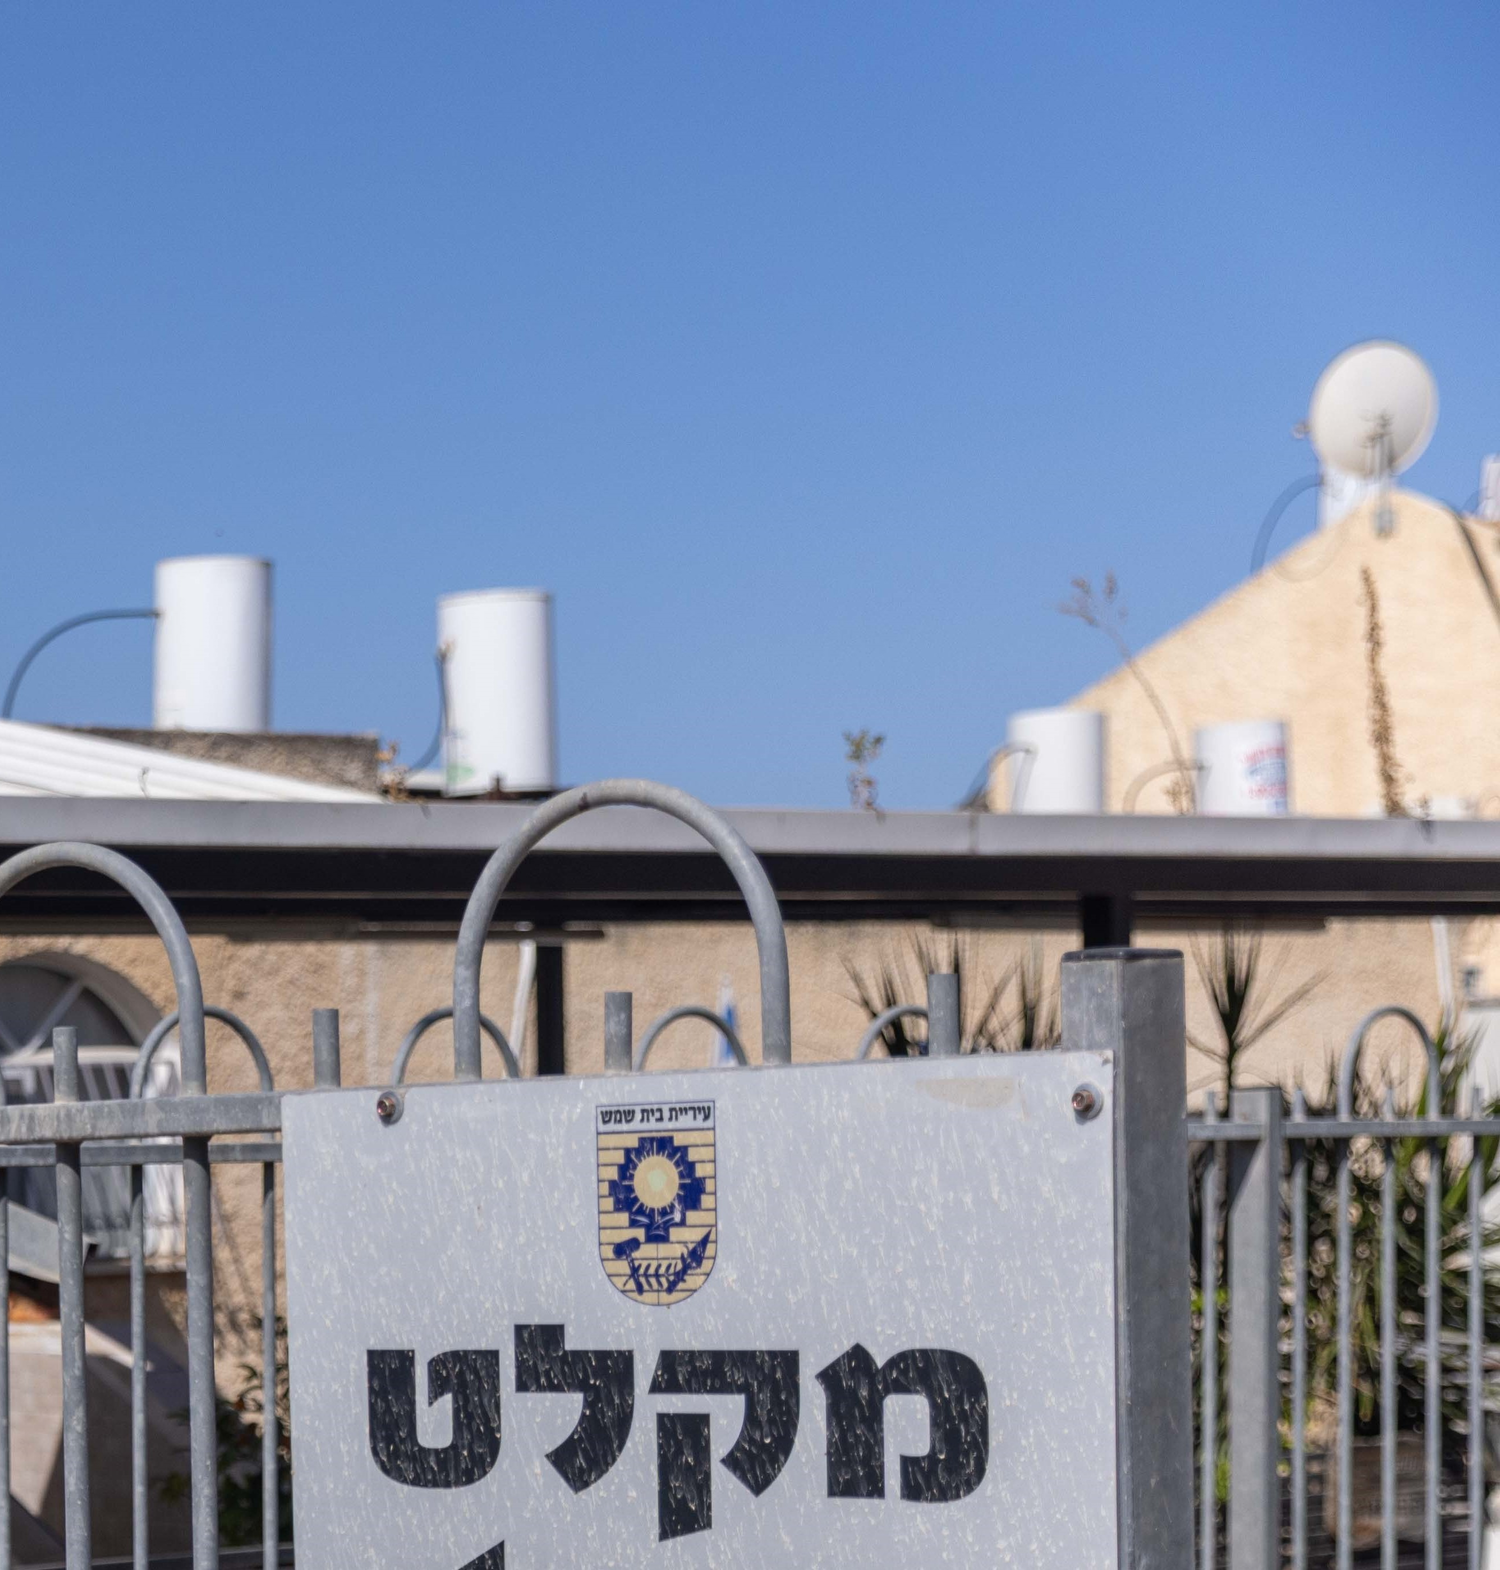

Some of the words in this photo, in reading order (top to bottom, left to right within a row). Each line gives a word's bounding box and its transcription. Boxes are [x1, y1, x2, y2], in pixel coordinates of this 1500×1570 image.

[600, 1109, 636, 1125] שמש
[639, 1107, 664, 1123] בית
[668, 1105, 712, 1122] עיריית
[366, 1323, 990, 1542] מקלט
